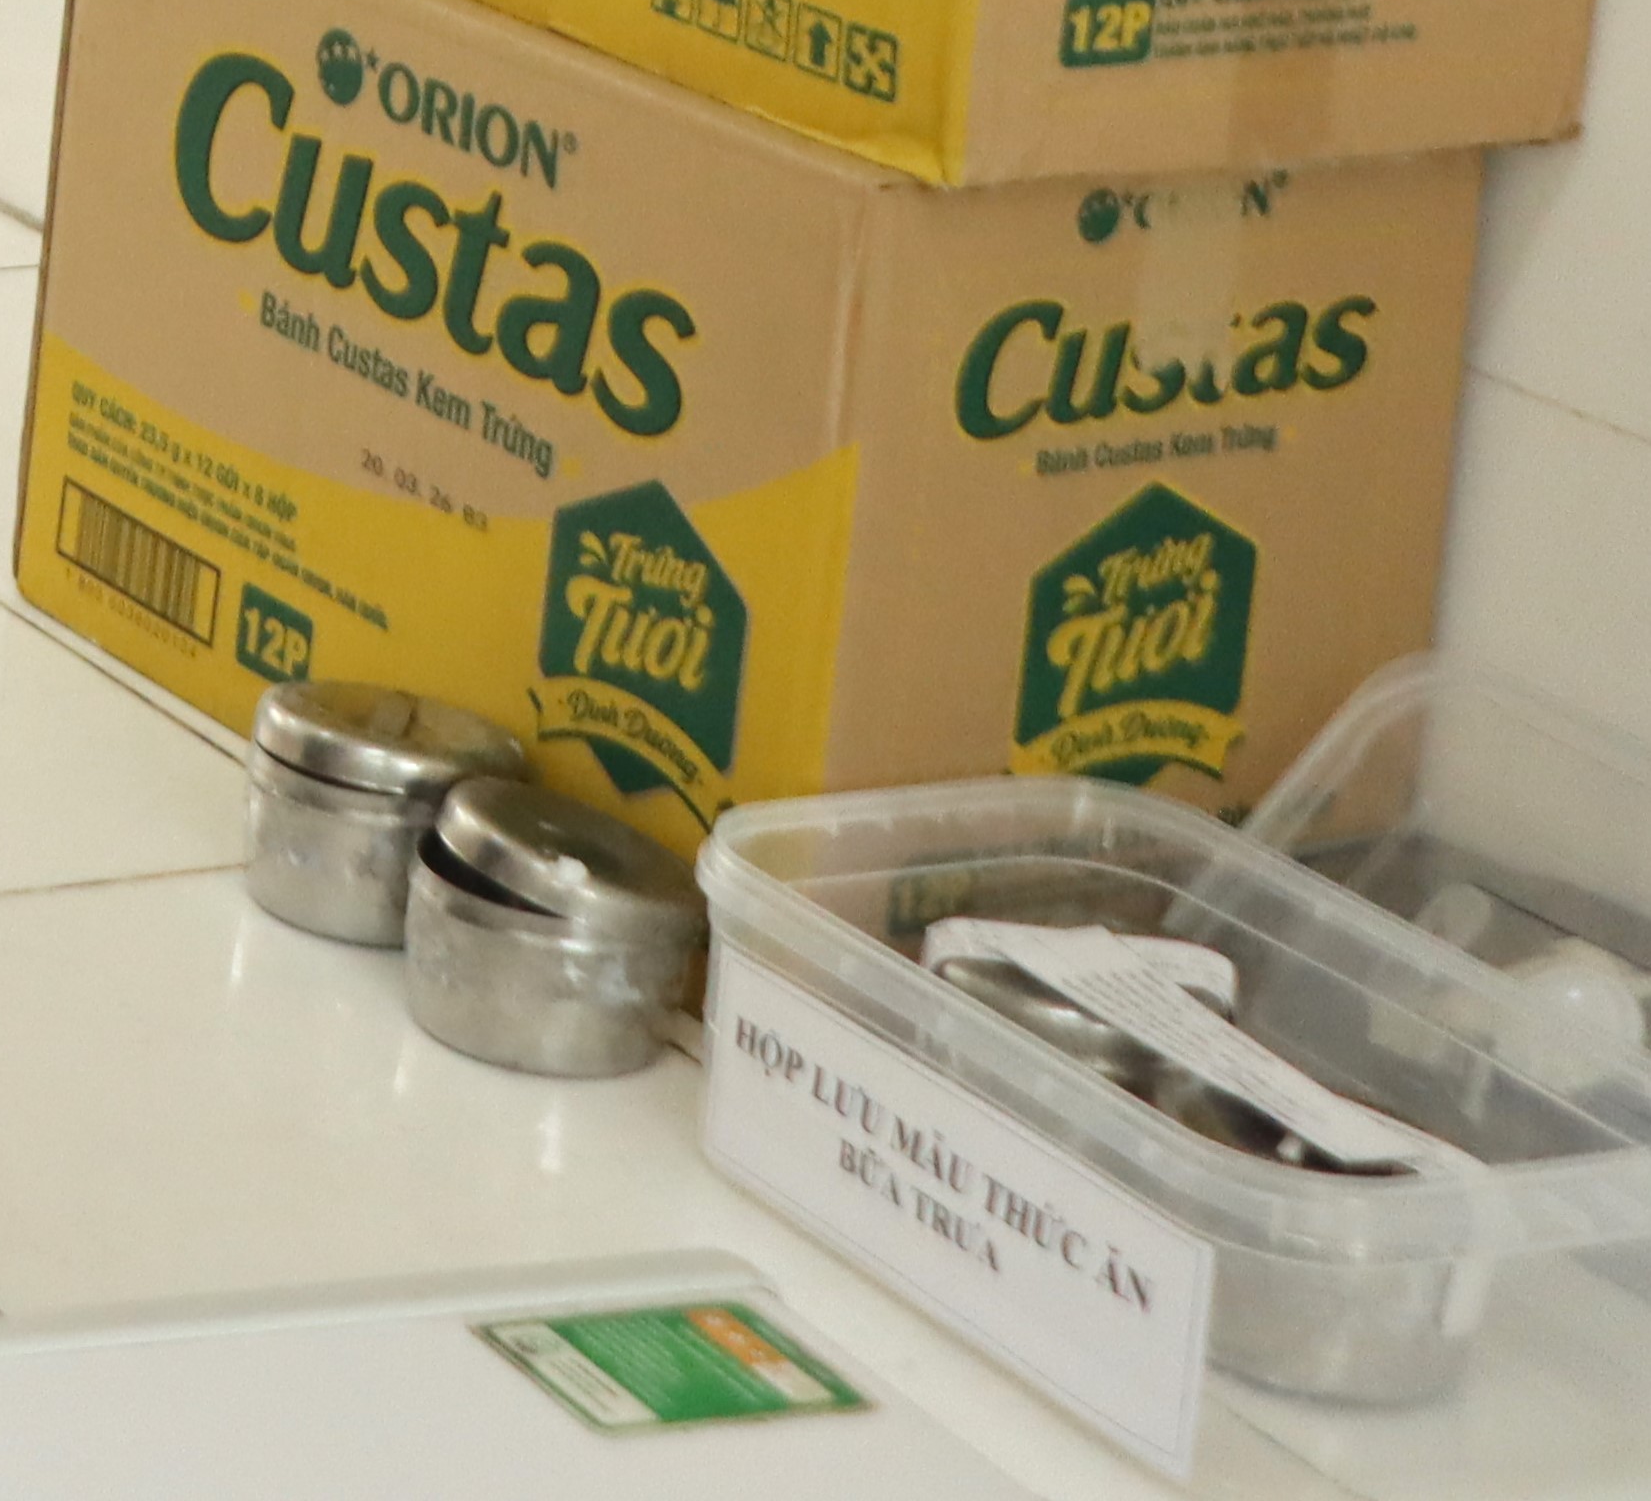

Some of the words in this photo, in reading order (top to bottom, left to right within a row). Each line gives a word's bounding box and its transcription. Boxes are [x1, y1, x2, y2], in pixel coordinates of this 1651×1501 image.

[1068, 0, 1150, 55] 12P
[377, 62, 560, 189] ORION
[174, 52, 697, 438] Custas
[259, 291, 322, 354] Bánh
[327, 323, 408, 399] Custas
[415, 371, 472, 431] Kem
[479, 397, 554, 479] Trứng
[196, 451, 215, 479] 12
[1094, 439, 1164, 468] Custas
[1169, 432, 1215, 457] Kem
[608, 530, 708, 610] Trứng
[244, 606, 307, 677] 12P
[565, 573, 714, 691] Tươi
[1047, 569, 1219, 718] Tươi
[735, 1015, 805, 1084] HỘP
[810, 1064, 889, 1135] LƯU
[890, 1115, 978, 1195] MẪU
[979, 1172, 1088, 1271] THỨC
[1091, 1246, 1157, 1314] ĂN
[836, 1136, 903, 1210] BỮA
[911, 1192, 1001, 1275] TRƯA
